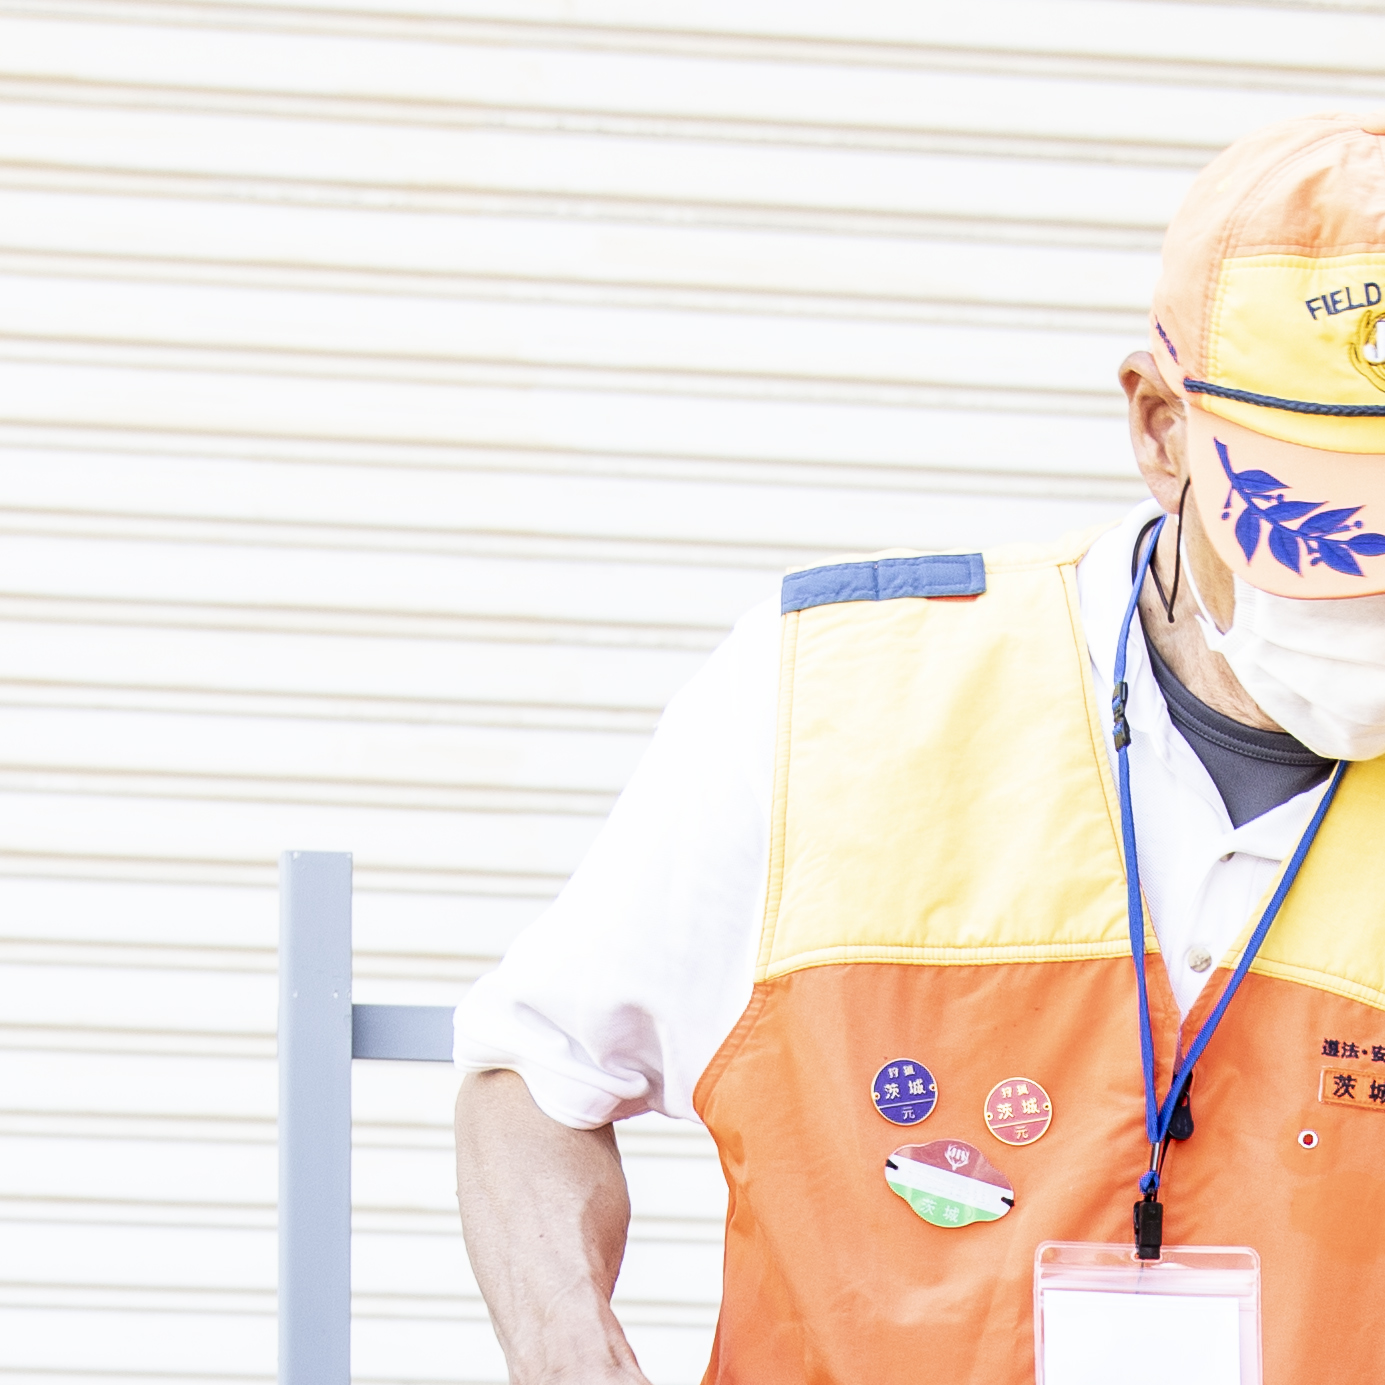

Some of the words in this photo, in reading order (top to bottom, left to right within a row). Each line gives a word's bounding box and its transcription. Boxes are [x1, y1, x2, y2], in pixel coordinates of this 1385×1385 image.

[1305, 282, 1382, 321] FIELD
[883, 1078, 926, 1100] 茨城
[902, 1106, 916, 1120] 元
[996, 1097, 1040, 1120] 茨城
[1014, 1126, 1029, 1140] 元
[919, 1198, 961, 1223] 茨城
